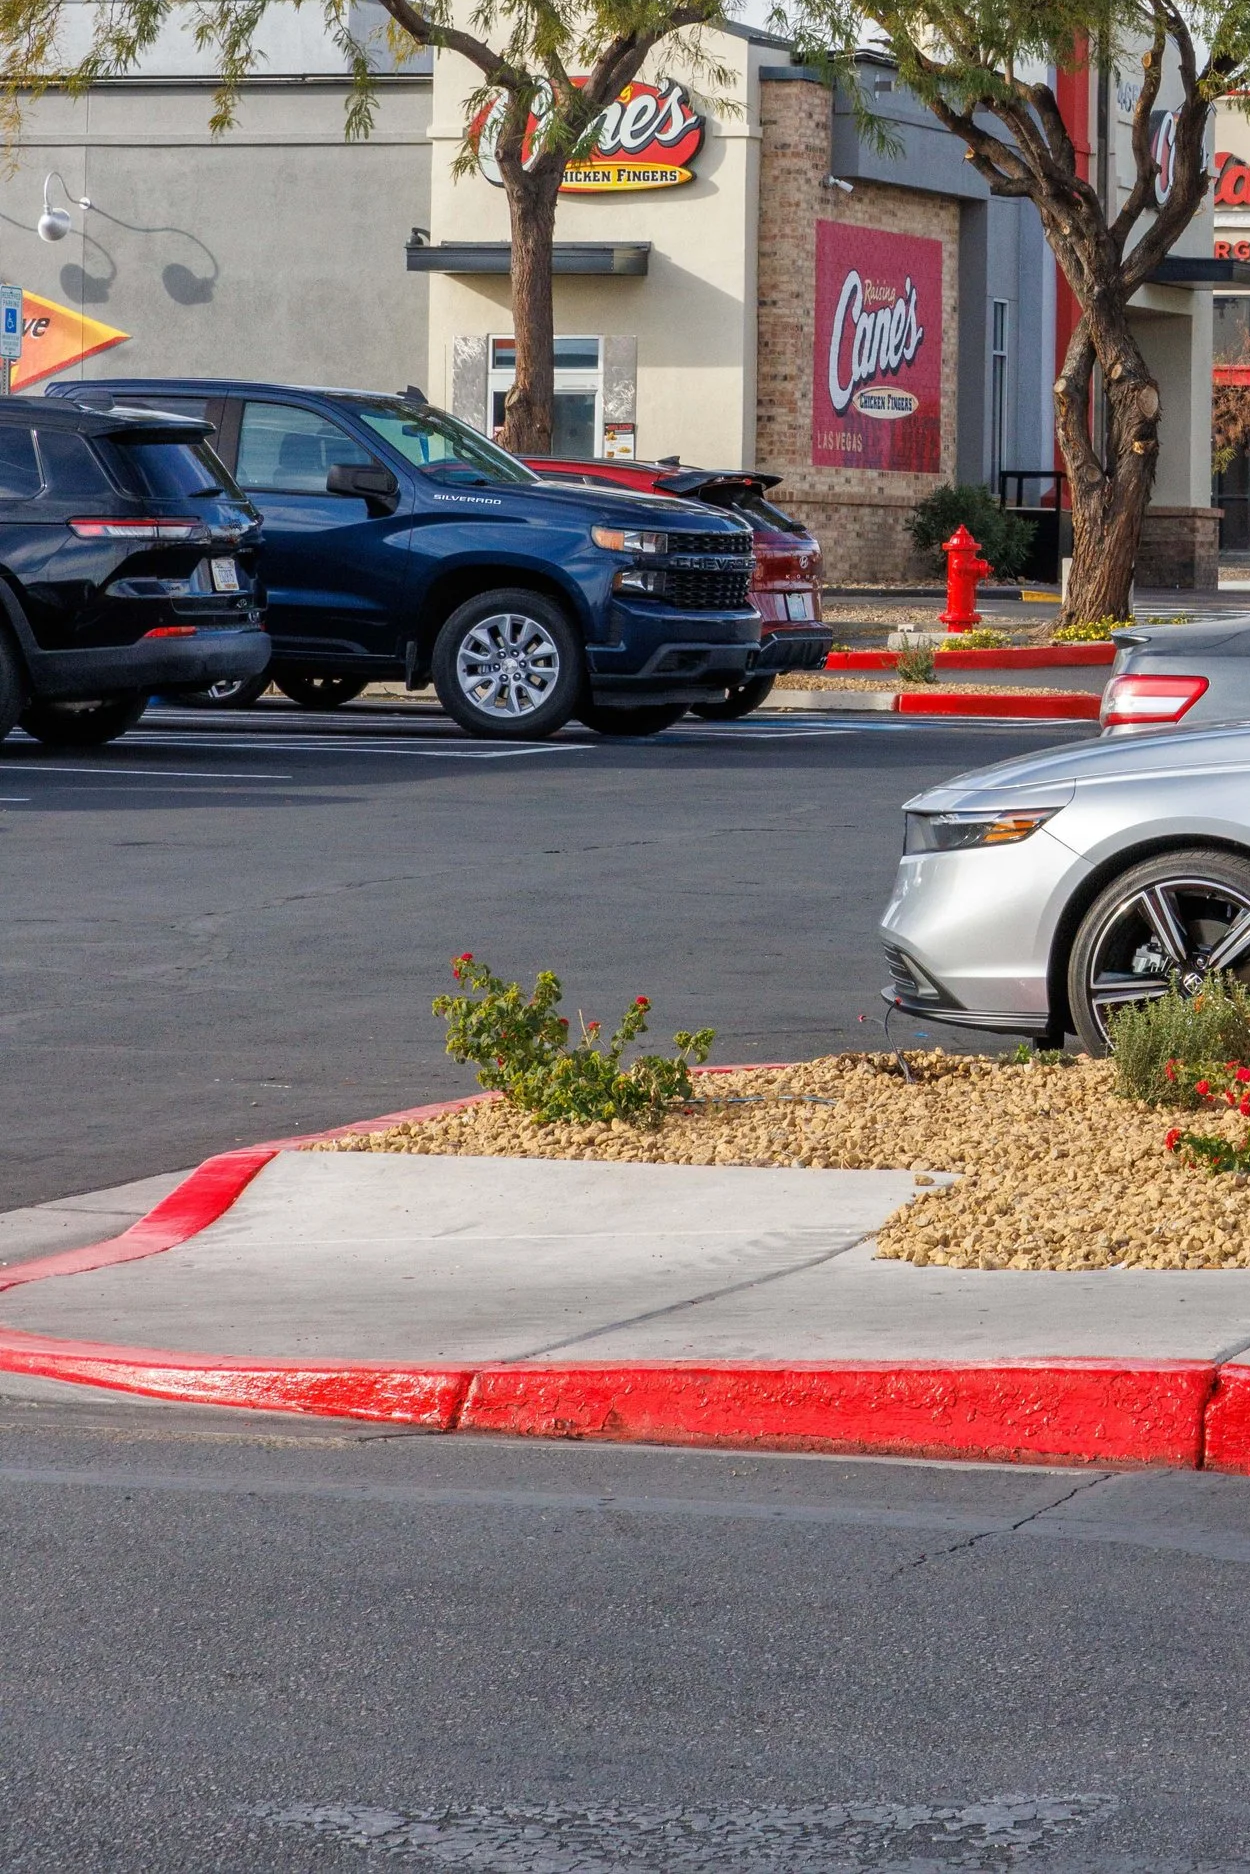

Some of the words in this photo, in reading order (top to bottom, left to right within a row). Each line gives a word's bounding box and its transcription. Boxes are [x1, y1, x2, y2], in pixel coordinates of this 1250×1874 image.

[562, 169, 611, 182] HICKEN
[616, 168, 678, 182] FINGERS
[863, 279, 897, 305] Raising
[21, 317, 50, 337] ve
[829, 269, 923, 412] Cane's
[859, 392, 886, 410] CHICKEN
[887, 393, 913, 412] FINGERS
[817, 430, 834, 450] LAS
[835, 432, 863, 452] VEGAS
[433, 494, 502, 505] SILVERADO
